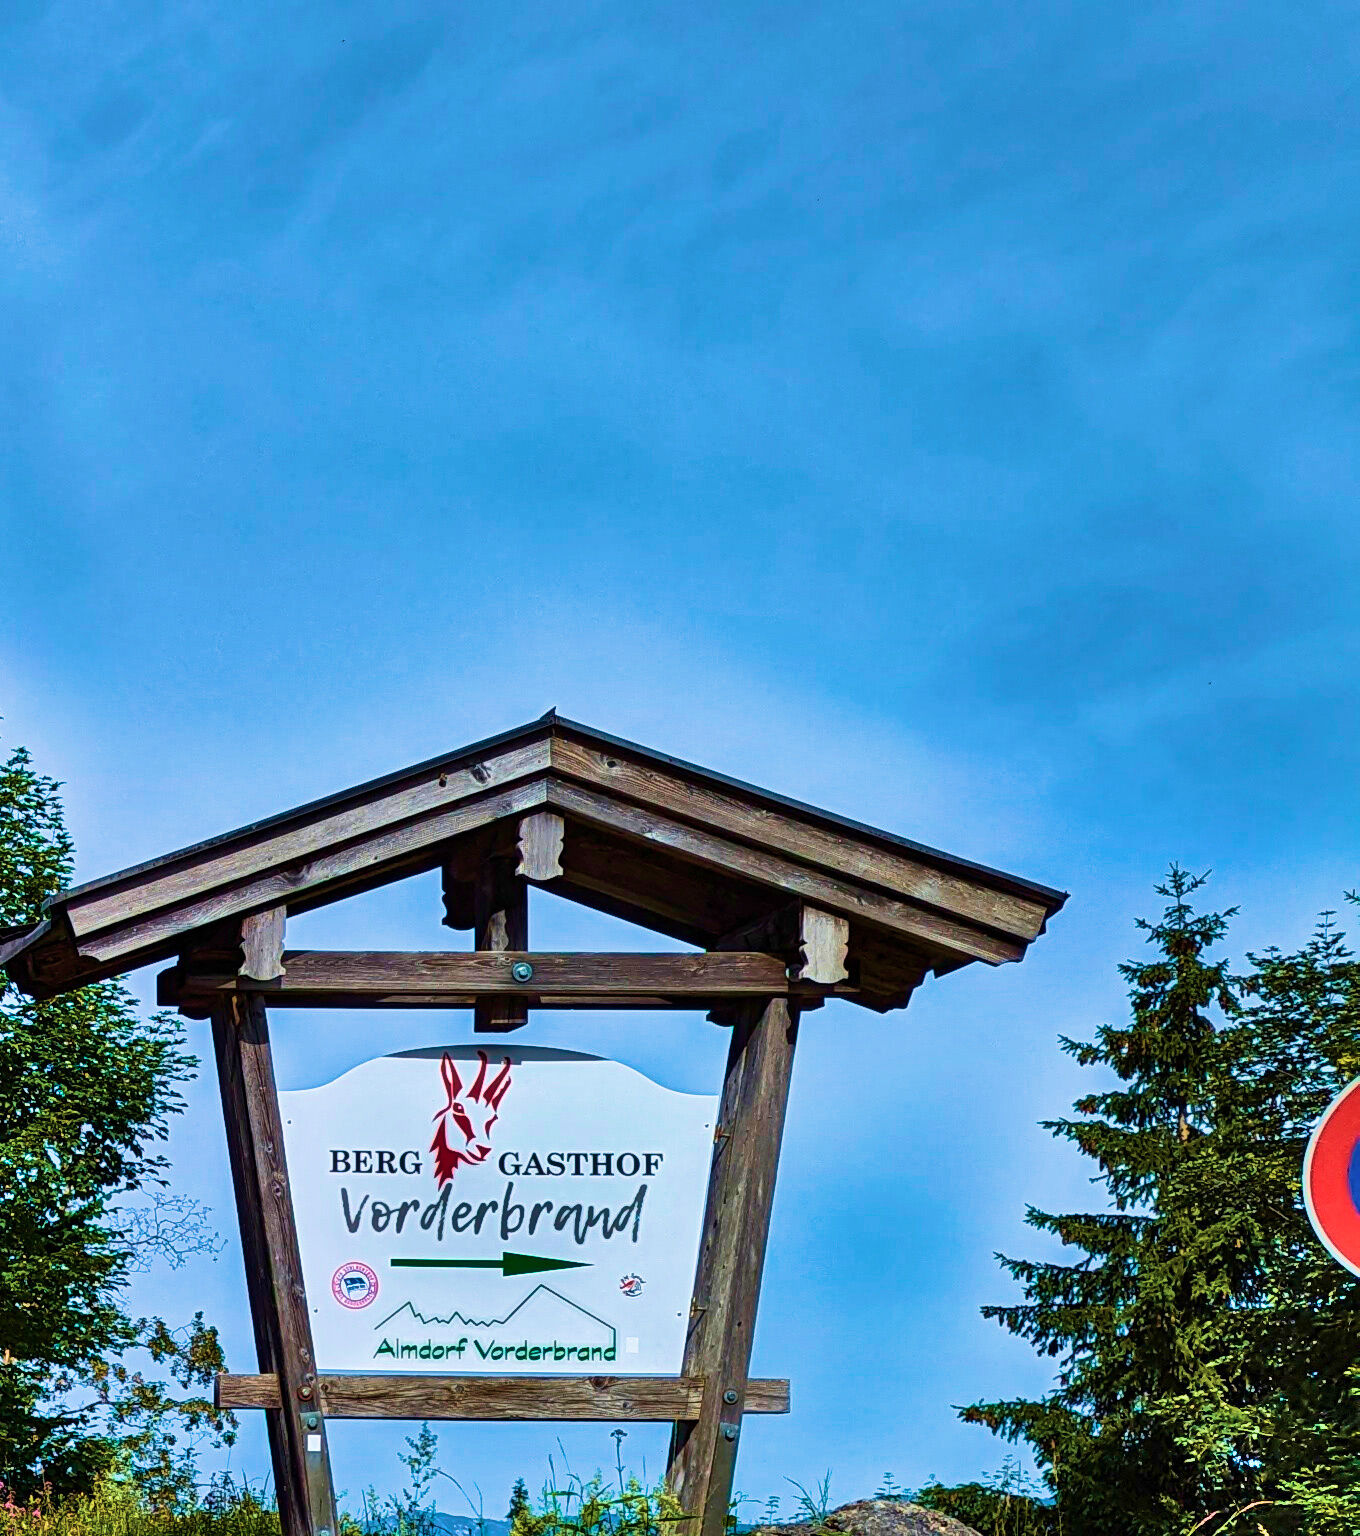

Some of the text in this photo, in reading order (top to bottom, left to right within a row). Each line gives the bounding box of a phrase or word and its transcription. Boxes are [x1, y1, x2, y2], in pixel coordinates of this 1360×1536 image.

[329, 1150, 664, 1176] BERG GASTHOF
[340, 1181, 648, 1245] Vorderbrand
[373, 1337, 616, 1361] Almdorf Vorderbrand
